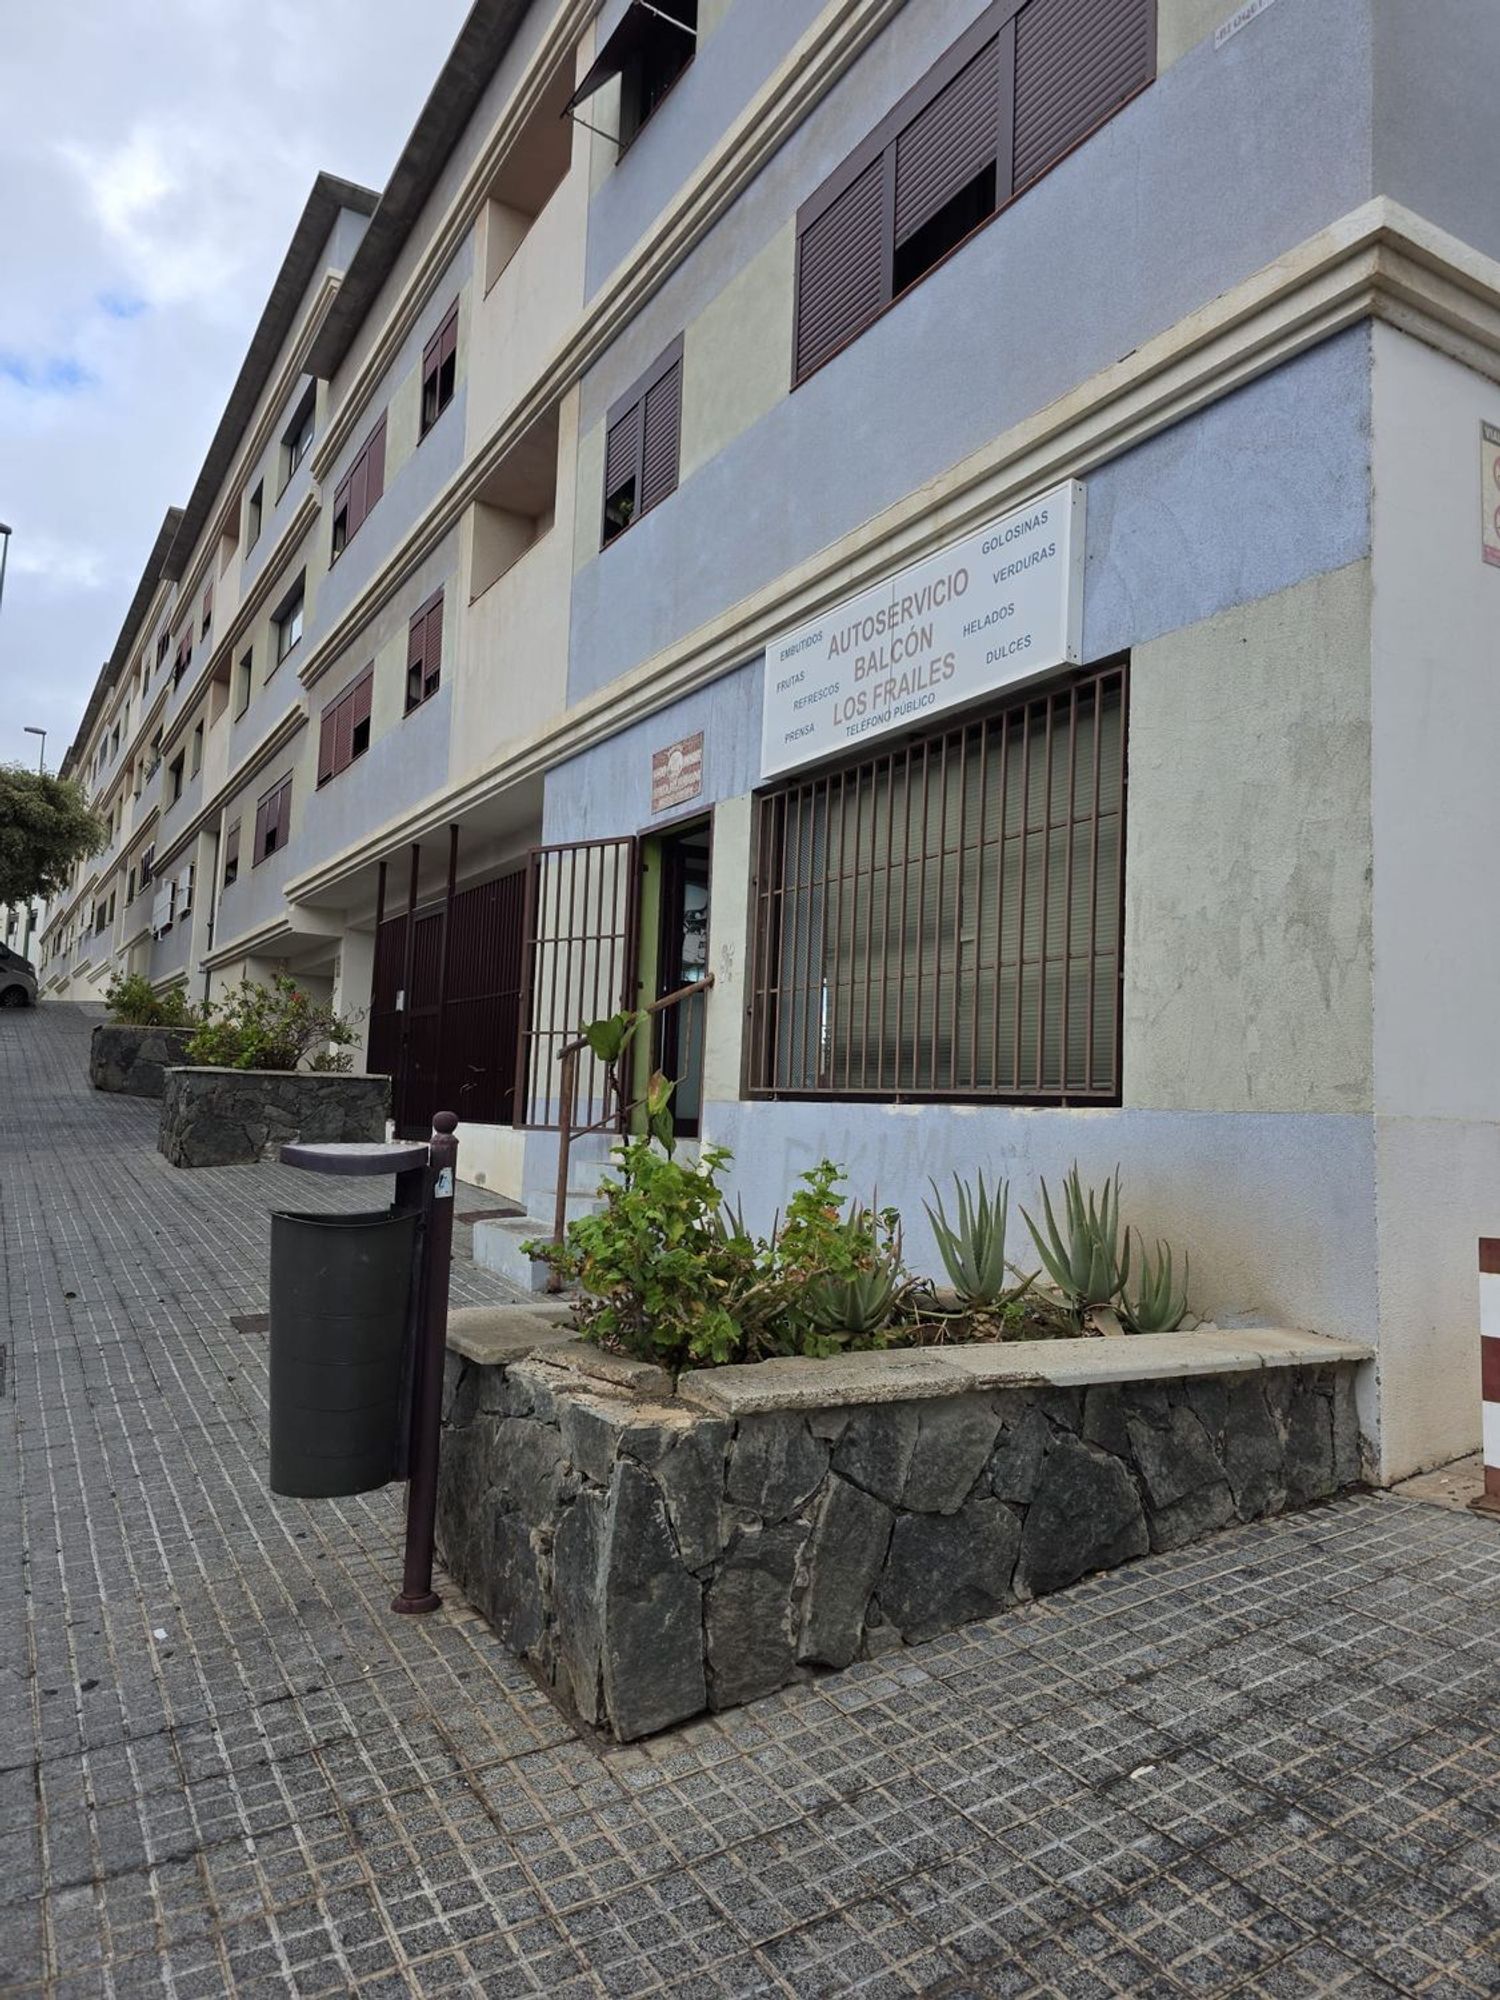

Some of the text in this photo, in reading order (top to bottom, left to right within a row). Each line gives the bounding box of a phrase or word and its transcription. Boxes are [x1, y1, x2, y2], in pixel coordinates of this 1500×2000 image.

[982, 510, 1049, 555] GOLOSINAS
[993, 543, 1056, 584] VERDURAS
[827, 568, 969, 660] AUTOSERVICIO
[963, 602, 1015, 638] HELADOS
[780, 630, 823, 662] EMBUTIDOS
[854, 624, 933, 682] BALCÓN
[986, 634, 1032, 664] DULCES
[776, 671, 806, 694] FRUTAS
[793, 682, 840, 712] REFRESCOS
[833, 652, 956, 726] LOS FRAILES
[784, 723, 815, 745] PRENSA
